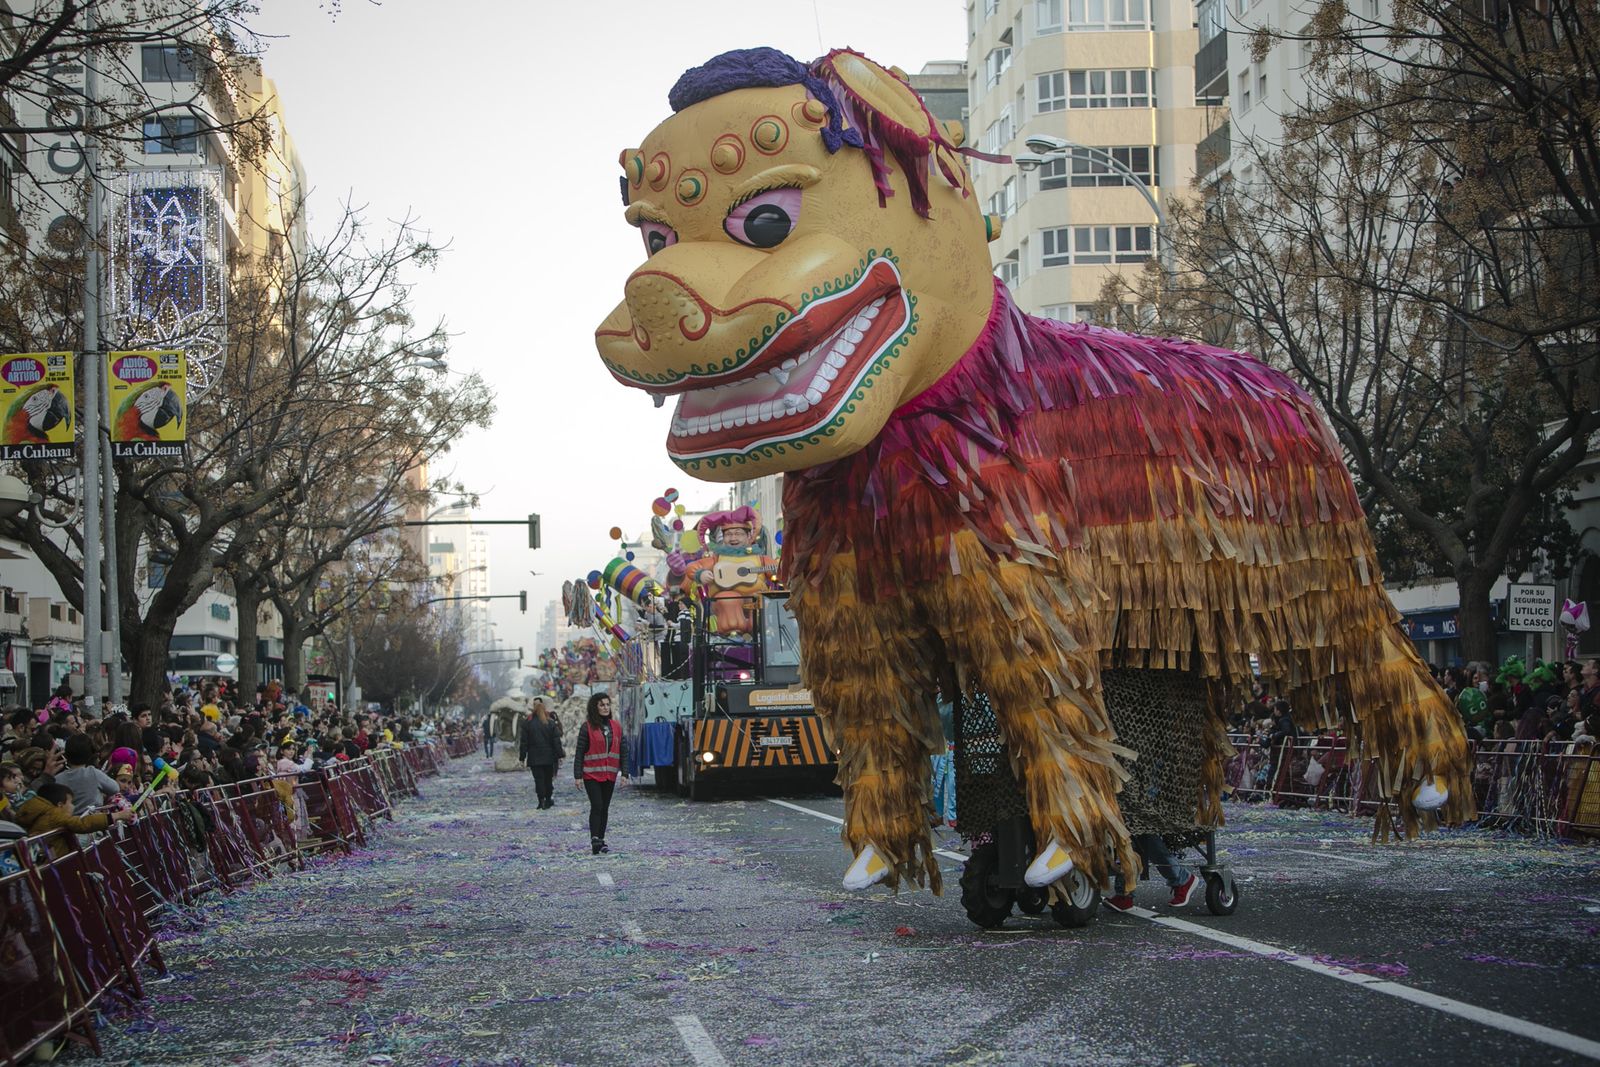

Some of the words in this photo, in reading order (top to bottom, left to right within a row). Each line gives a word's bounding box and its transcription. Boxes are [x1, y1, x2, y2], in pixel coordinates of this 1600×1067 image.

[11, 359, 36, 371] ADIÓS
[123, 356, 149, 368] ADIÓS
[8, 371, 40, 382] ARTURO
[119, 368, 153, 379] ARTURO
[4, 446, 21, 459] La
[22, 444, 71, 459] Cubana
[115, 443, 133, 456] La
[133, 442, 182, 456] Cubana
[1515, 607, 1549, 616] UTILICE
[1442, 620, 1456, 634] MGS
[1510, 618, 1521, 626] EL
[1523, 618, 1553, 627] CASCO
